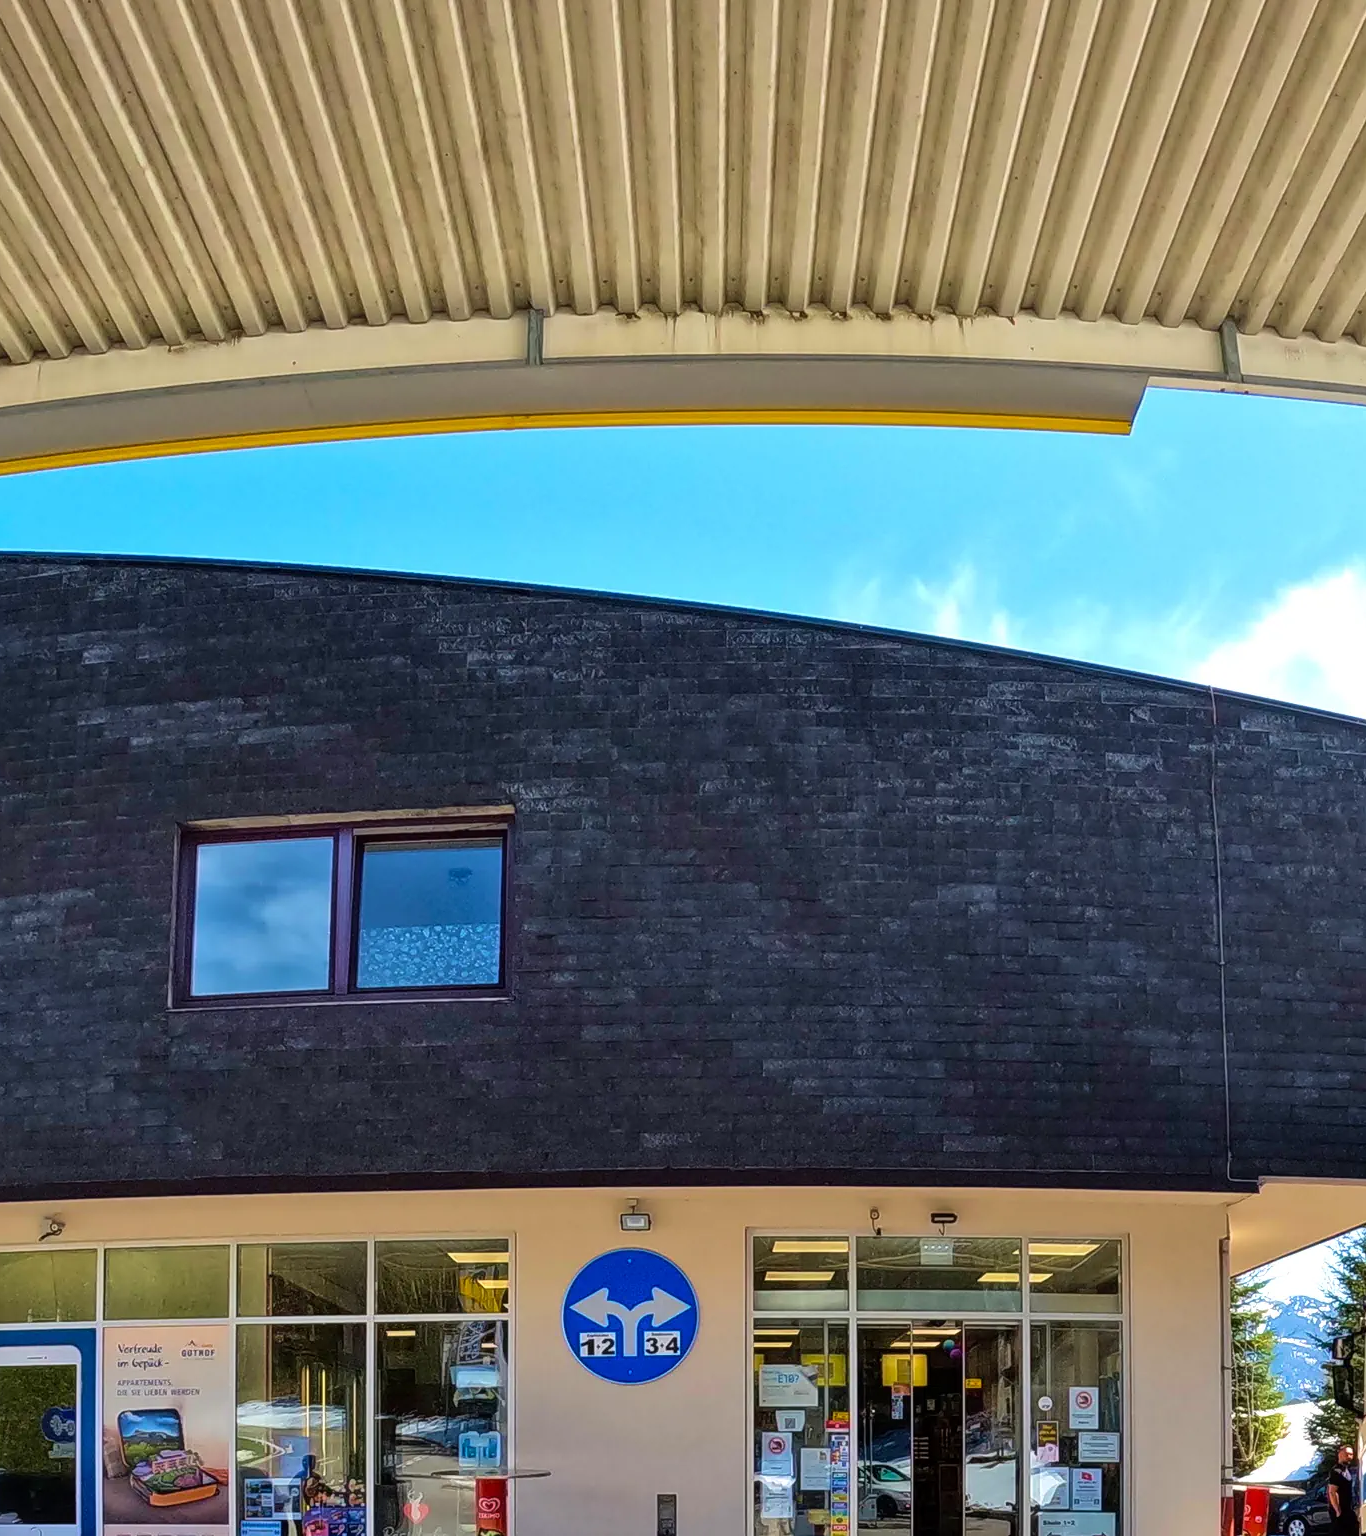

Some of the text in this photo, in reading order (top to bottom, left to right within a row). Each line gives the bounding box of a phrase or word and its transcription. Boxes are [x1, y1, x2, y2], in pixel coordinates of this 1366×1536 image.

[117, 1343, 162, 1354] Vorfreude
[117, 1359, 129, 1368] im
[777, 1373, 800, 1384] E10?
[144, 1388, 167, 1396] LIEBEN
